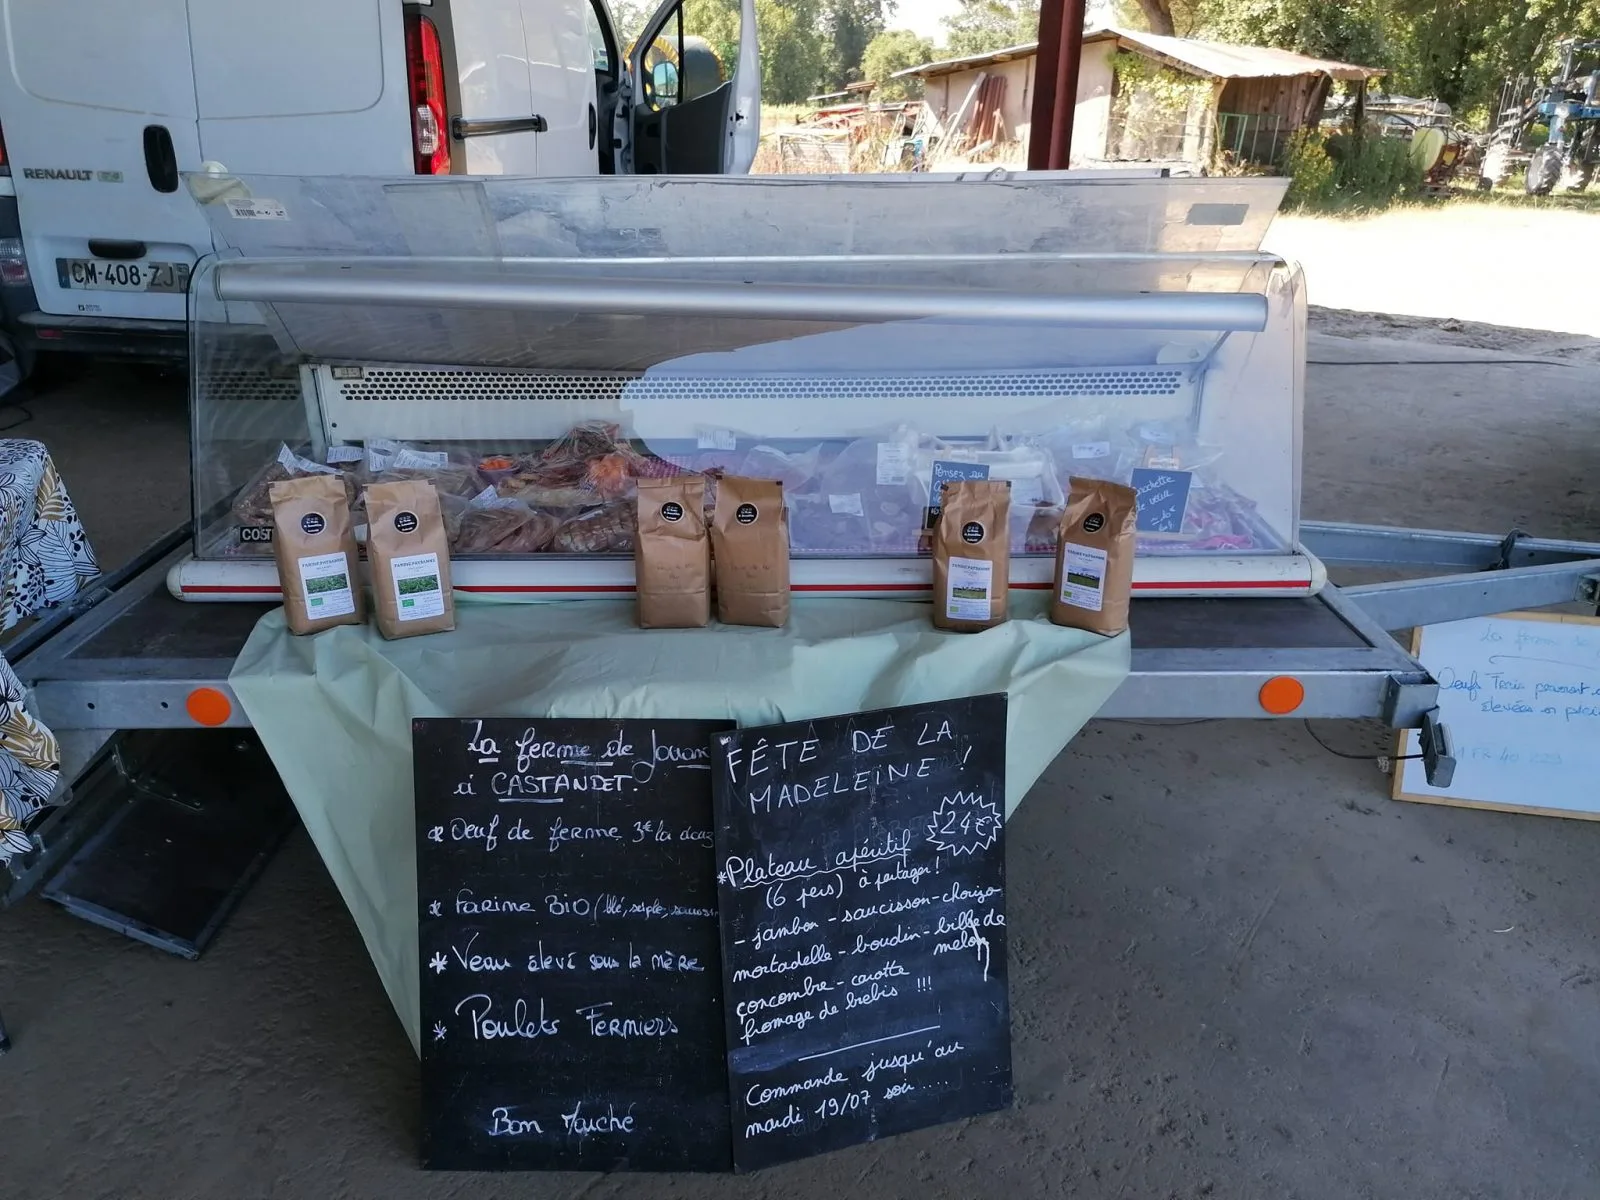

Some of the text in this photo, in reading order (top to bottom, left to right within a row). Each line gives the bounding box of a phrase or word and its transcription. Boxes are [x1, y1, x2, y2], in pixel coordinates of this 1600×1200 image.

[23, 168, 93, 181] RENAULT
[71, 262, 175, 287] CM-408-ZJ
[461, 719, 500, 754] La
[515, 727, 592, 773] ferme
[601, 729, 634, 757] de
[726, 720, 953, 784] FÊTE DE LA
[749, 757, 937, 814] MADELEINE
[508, 818, 536, 842] de
[548, 817, 623, 852] ferme
[655, 820, 672, 842] la
[725, 828, 913, 887] Plateau apéritif
[858, 868, 872, 887] à
[455, 888, 536, 914] Farine
[452, 932, 512, 972] Veau
[627, 941, 642, 970] la
[733, 945, 833, 983] mortadelle
[454, 993, 679, 1040] Poulets Fermiers
[740, 1009, 815, 1045] fromage
[819, 1000, 839, 1019] de
[845, 983, 899, 1011] brebis
[746, 1067, 849, 1107] Commande
[488, 1106, 545, 1137] Bon
[745, 1103, 803, 1139] mardi
[815, 1089, 871, 1123] 19/07
